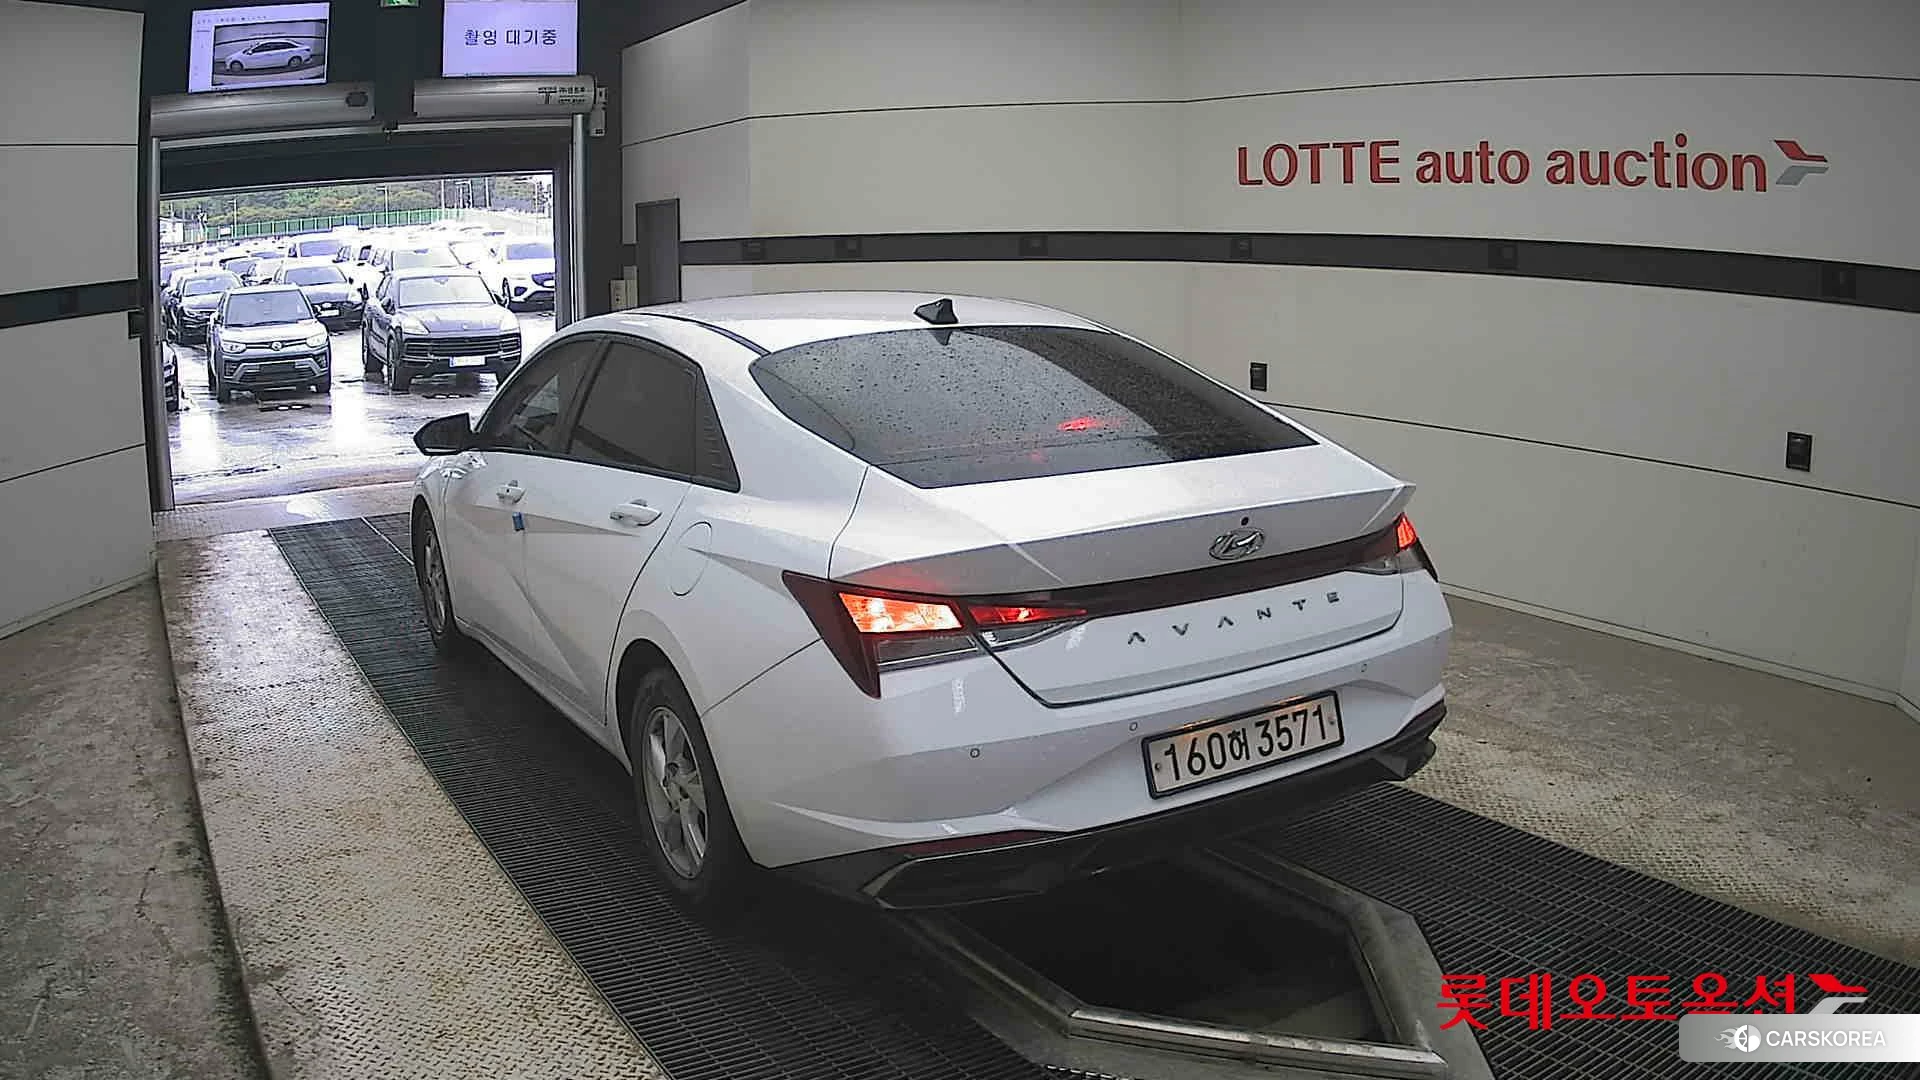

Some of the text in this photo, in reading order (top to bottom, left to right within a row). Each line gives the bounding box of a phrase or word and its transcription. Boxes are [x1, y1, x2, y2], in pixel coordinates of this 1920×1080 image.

[464, 29, 558, 46] 촬영 대기중
[1237, 133, 1768, 193] LOTTE auto auction
[1127, 591, 1340, 646] AVANTE
[1254, 704, 1327, 758] 3571
